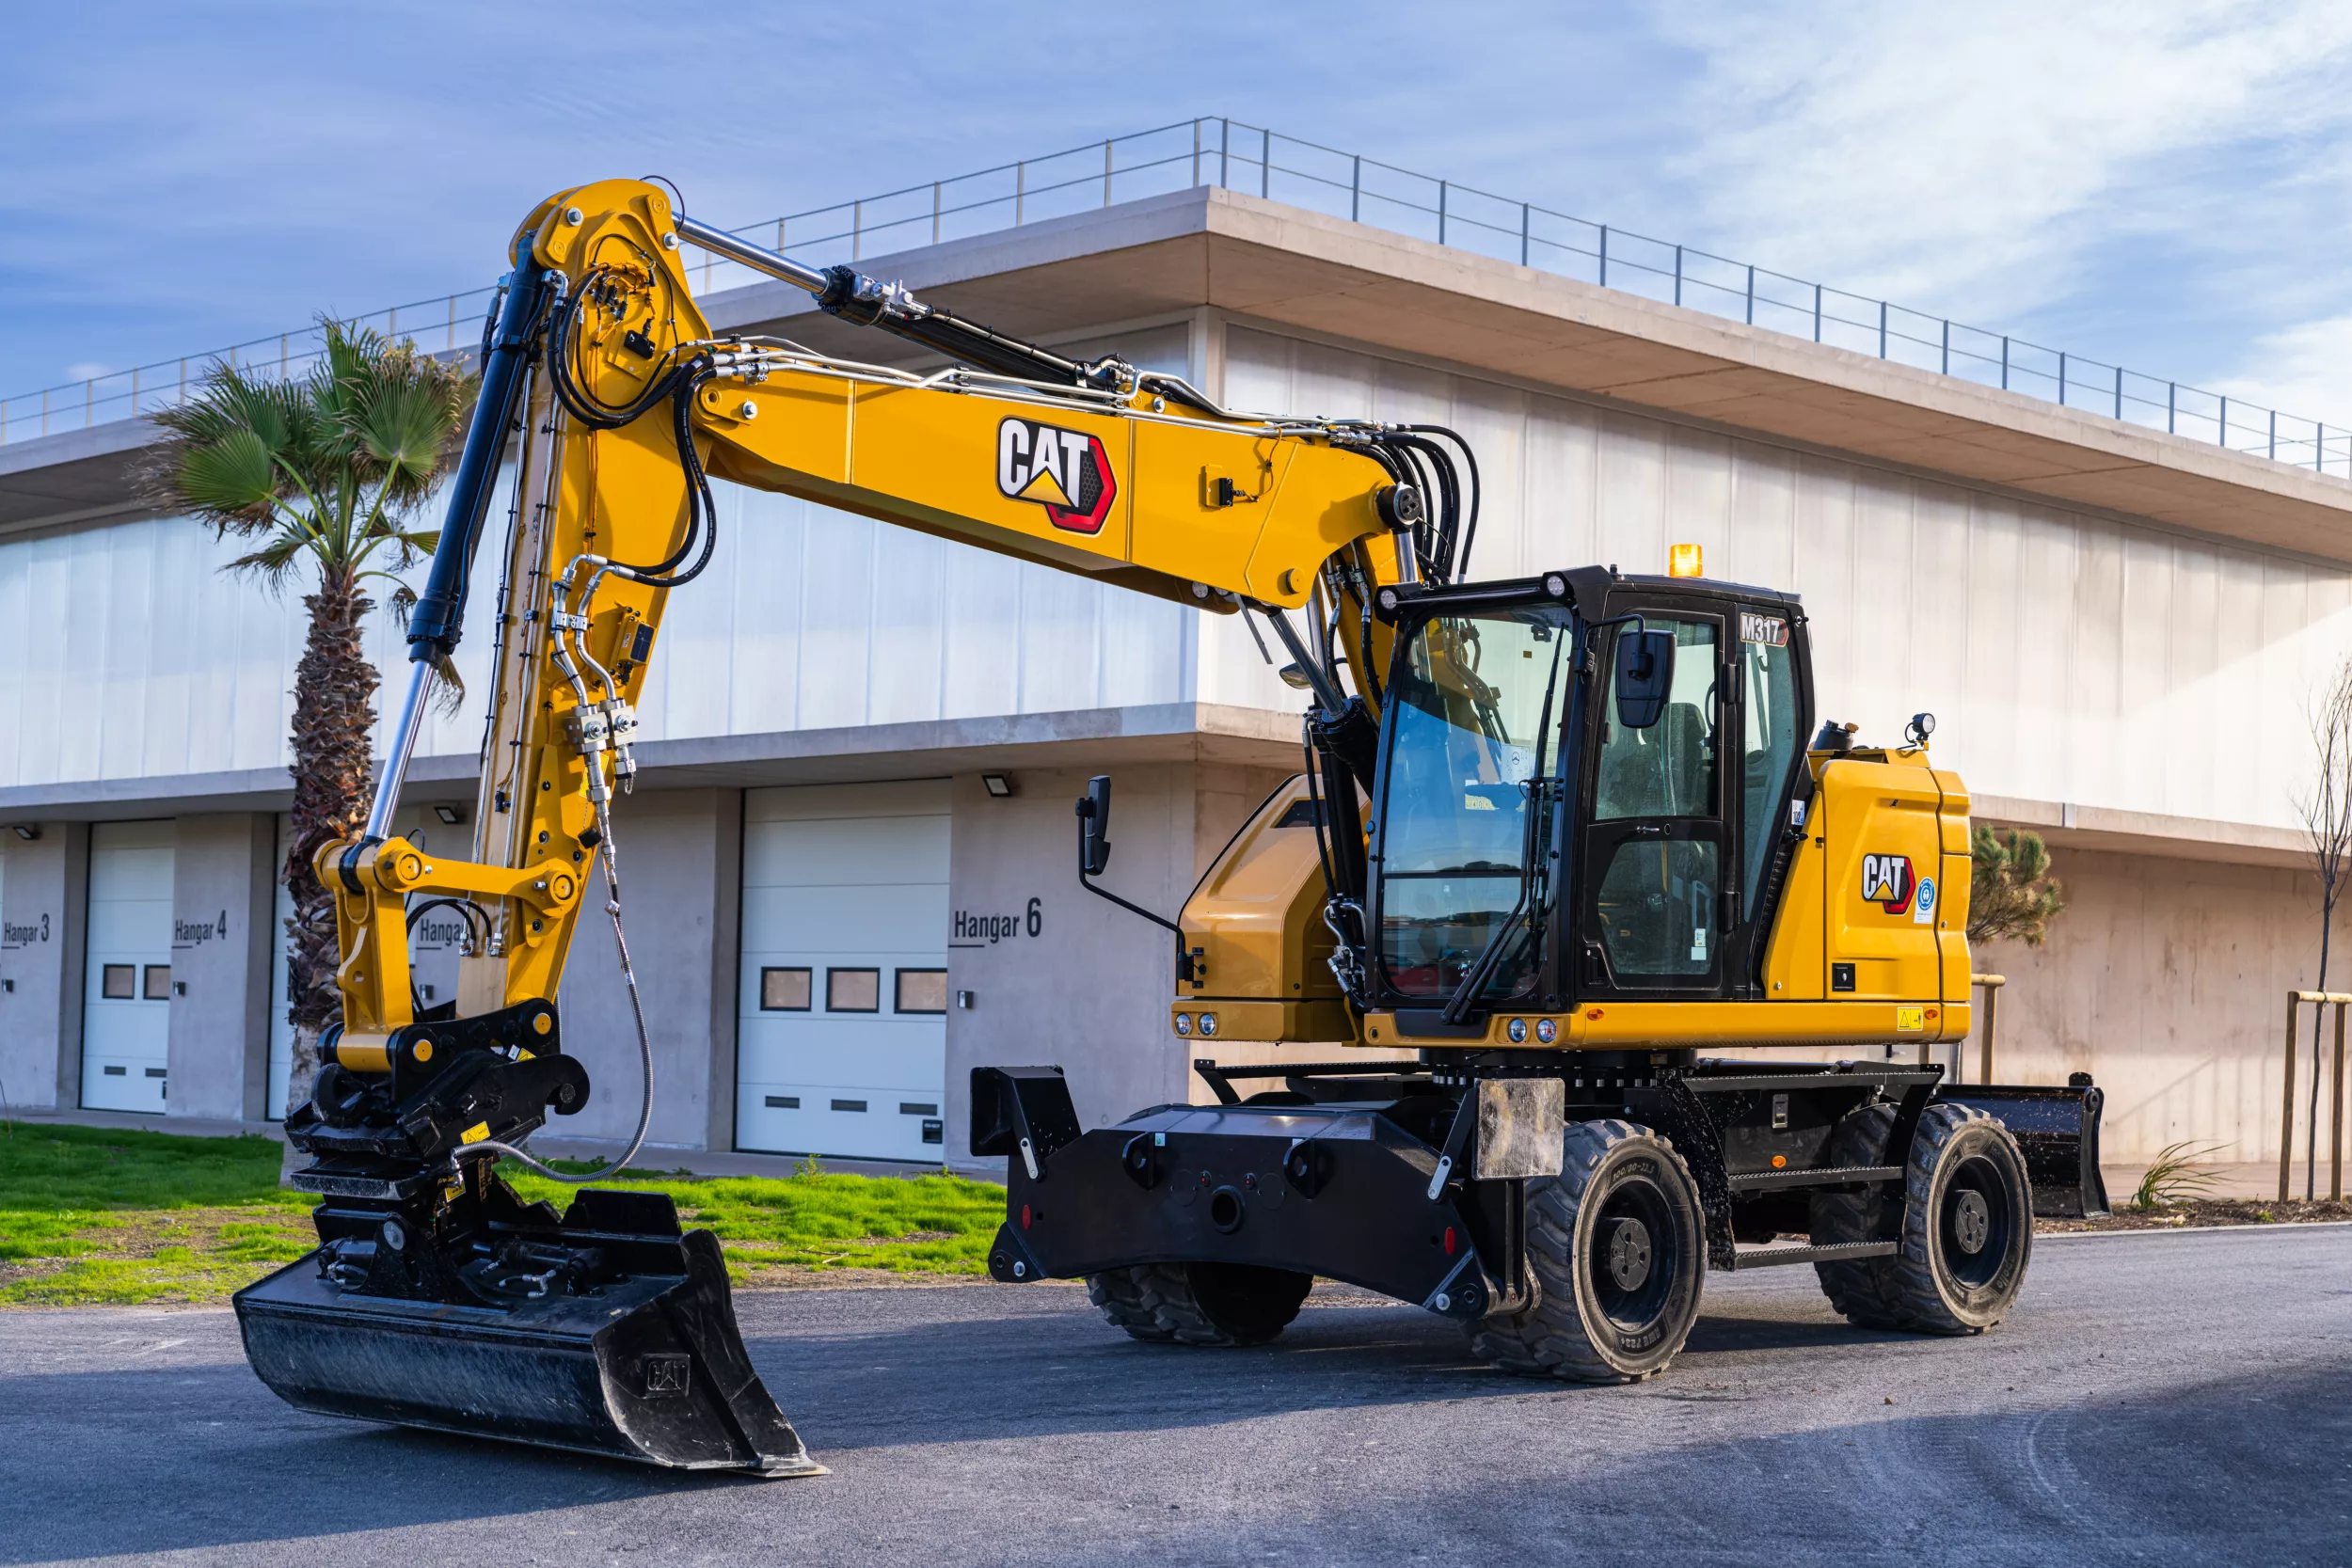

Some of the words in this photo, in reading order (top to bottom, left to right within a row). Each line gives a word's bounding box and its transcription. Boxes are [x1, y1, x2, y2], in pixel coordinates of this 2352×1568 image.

[999, 418, 1089, 509] CAT
[1741, 615, 1780, 643] M317
[1863, 854, 1905, 901] CAT
[5, 921, 39, 946] Hangar
[41, 912, 50, 942] 3
[175, 919, 215, 945] Hangar
[217, 909, 227, 941] 4
[420, 918, 465, 946] Hanga
[955, 910, 1021, 943] Hangar
[1026, 896, 1042, 938] 6
